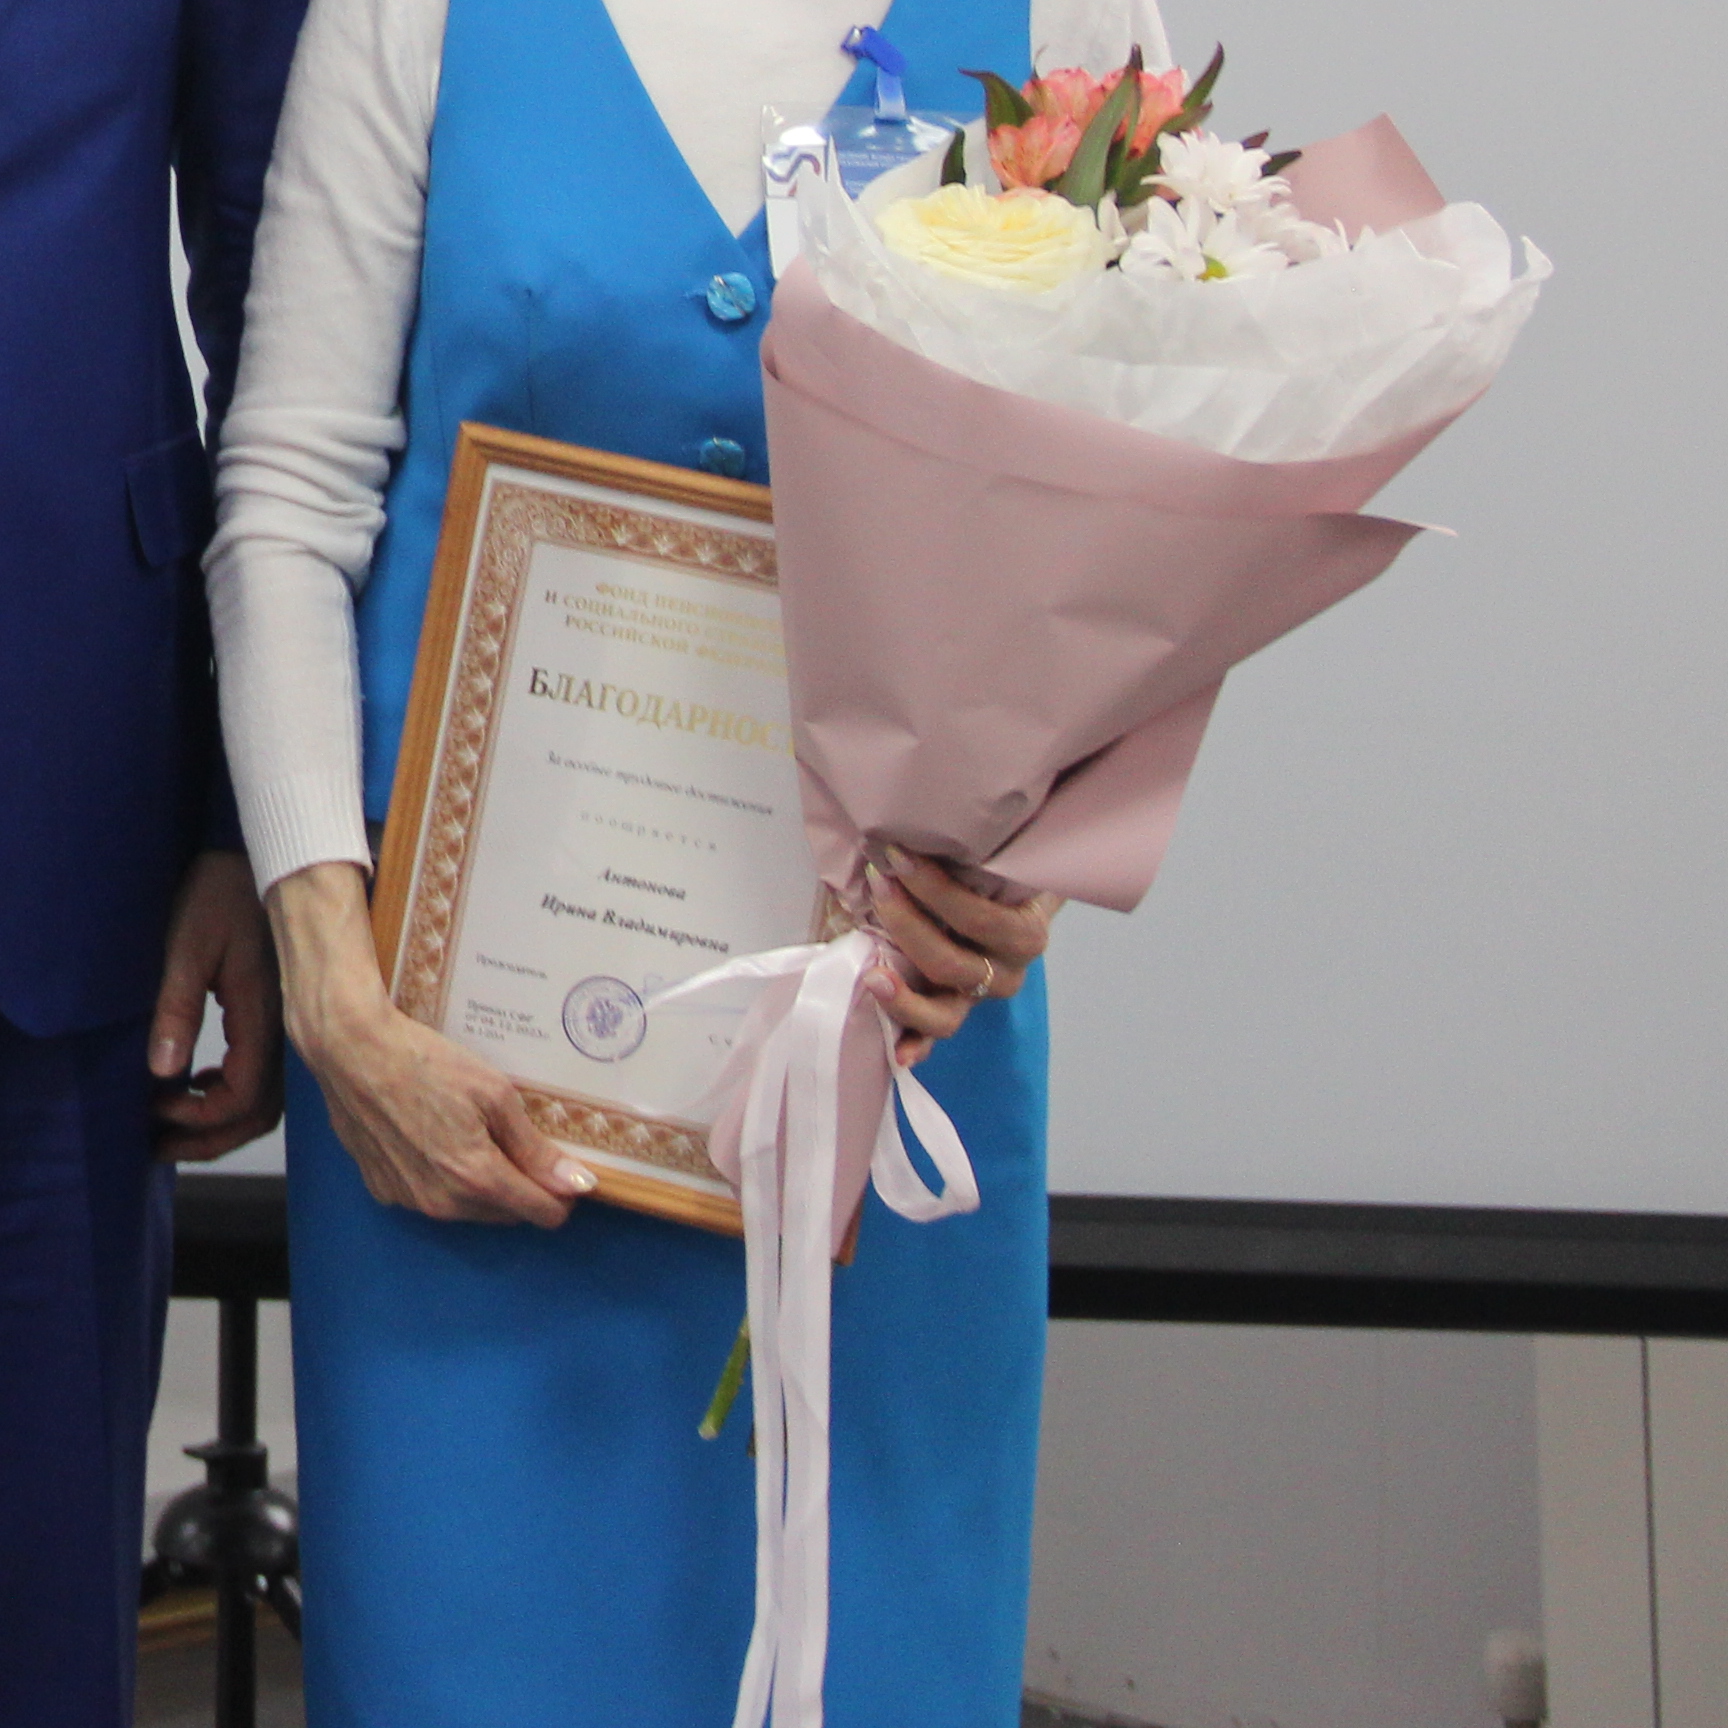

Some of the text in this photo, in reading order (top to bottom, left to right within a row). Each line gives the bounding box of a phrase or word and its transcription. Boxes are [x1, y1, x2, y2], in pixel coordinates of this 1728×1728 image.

[528, 665, 794, 756] БЛАГОДАРНОСТ
[597, 867, 687, 902] Антонова
[540, 892, 730, 955] Ирина Владимировна
